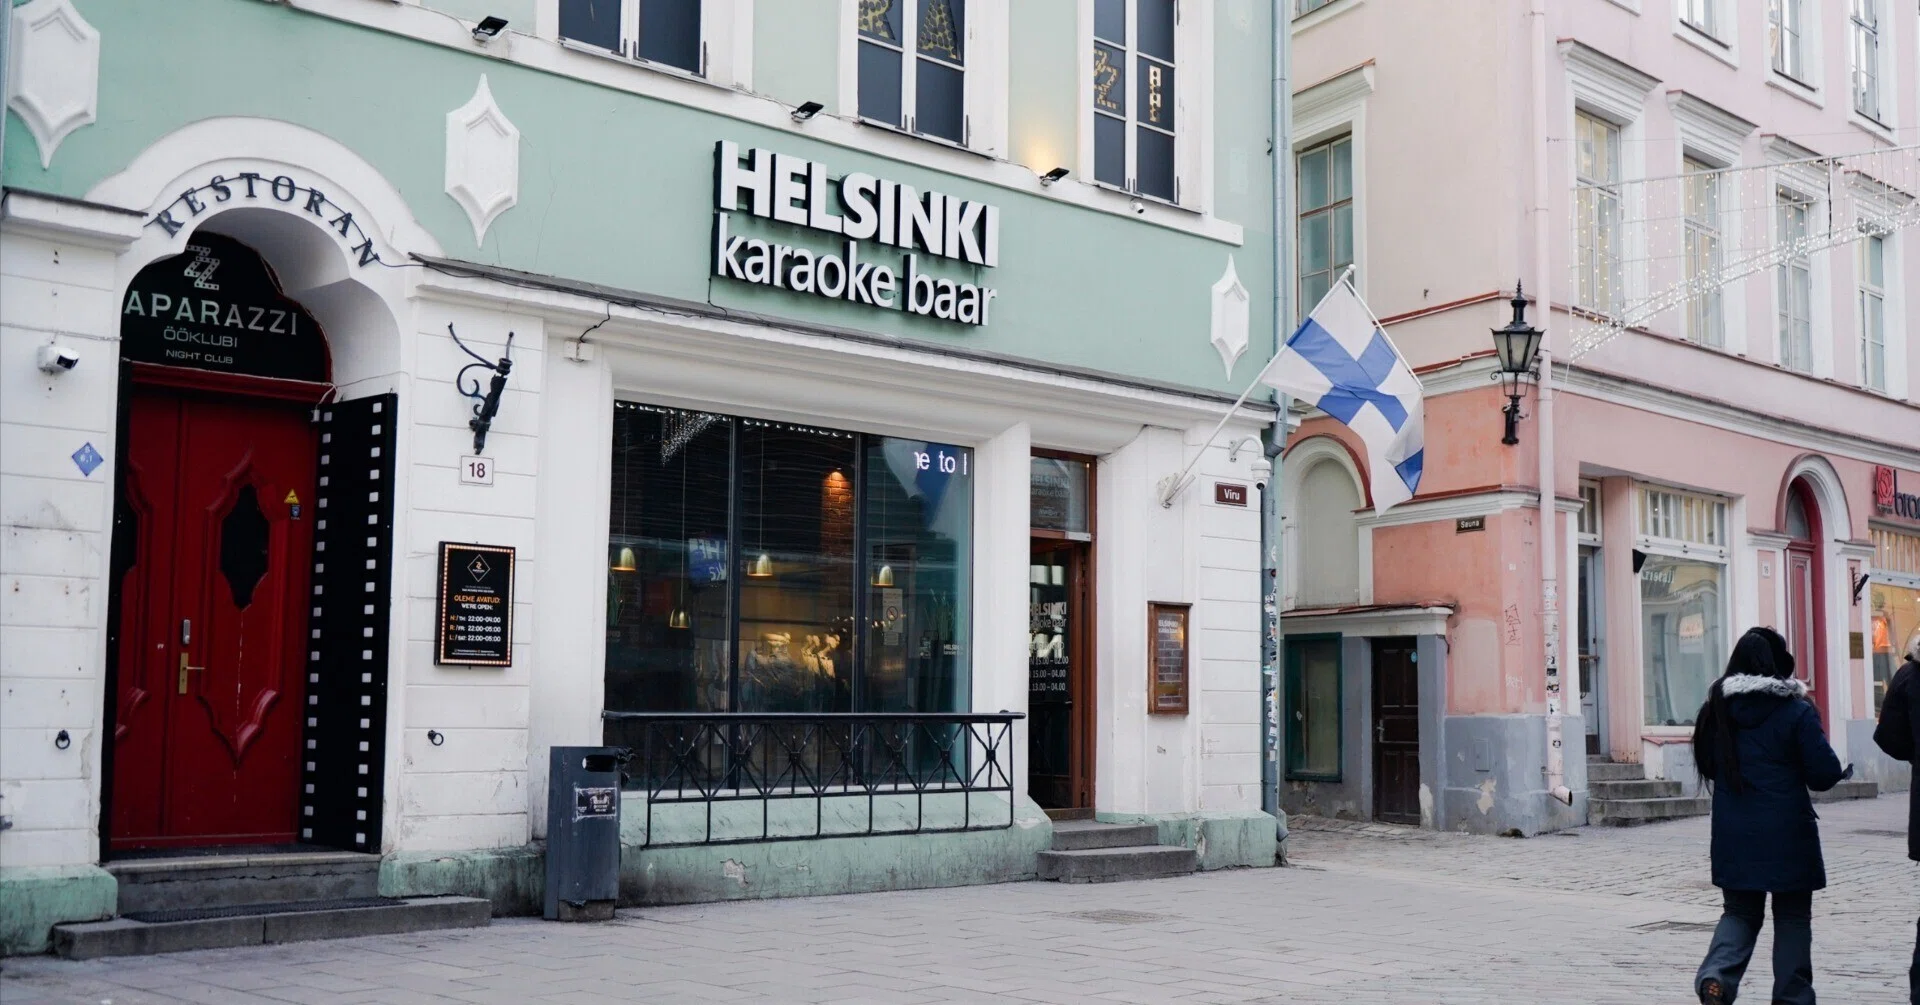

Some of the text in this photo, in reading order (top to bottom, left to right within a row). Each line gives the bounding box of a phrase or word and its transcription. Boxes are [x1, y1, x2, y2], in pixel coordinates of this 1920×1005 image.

[718, 140, 999, 268] HELSINKI
[155, 173, 380, 267] RESTORAN
[717, 212, 997, 326] karaoke baar
[124, 290, 297, 335] APARAZZI
[163, 325, 238, 348] ÖÖKLUBI
[166, 349, 233, 364] NIGHT CLUB
[469, 462, 485, 478] 18
[939, 450, 955, 473] to
[1224, 488, 1240, 500] Viru
[1461, 520, 1480, 528] Sauna
[454, 595, 475, 603] OLEME
